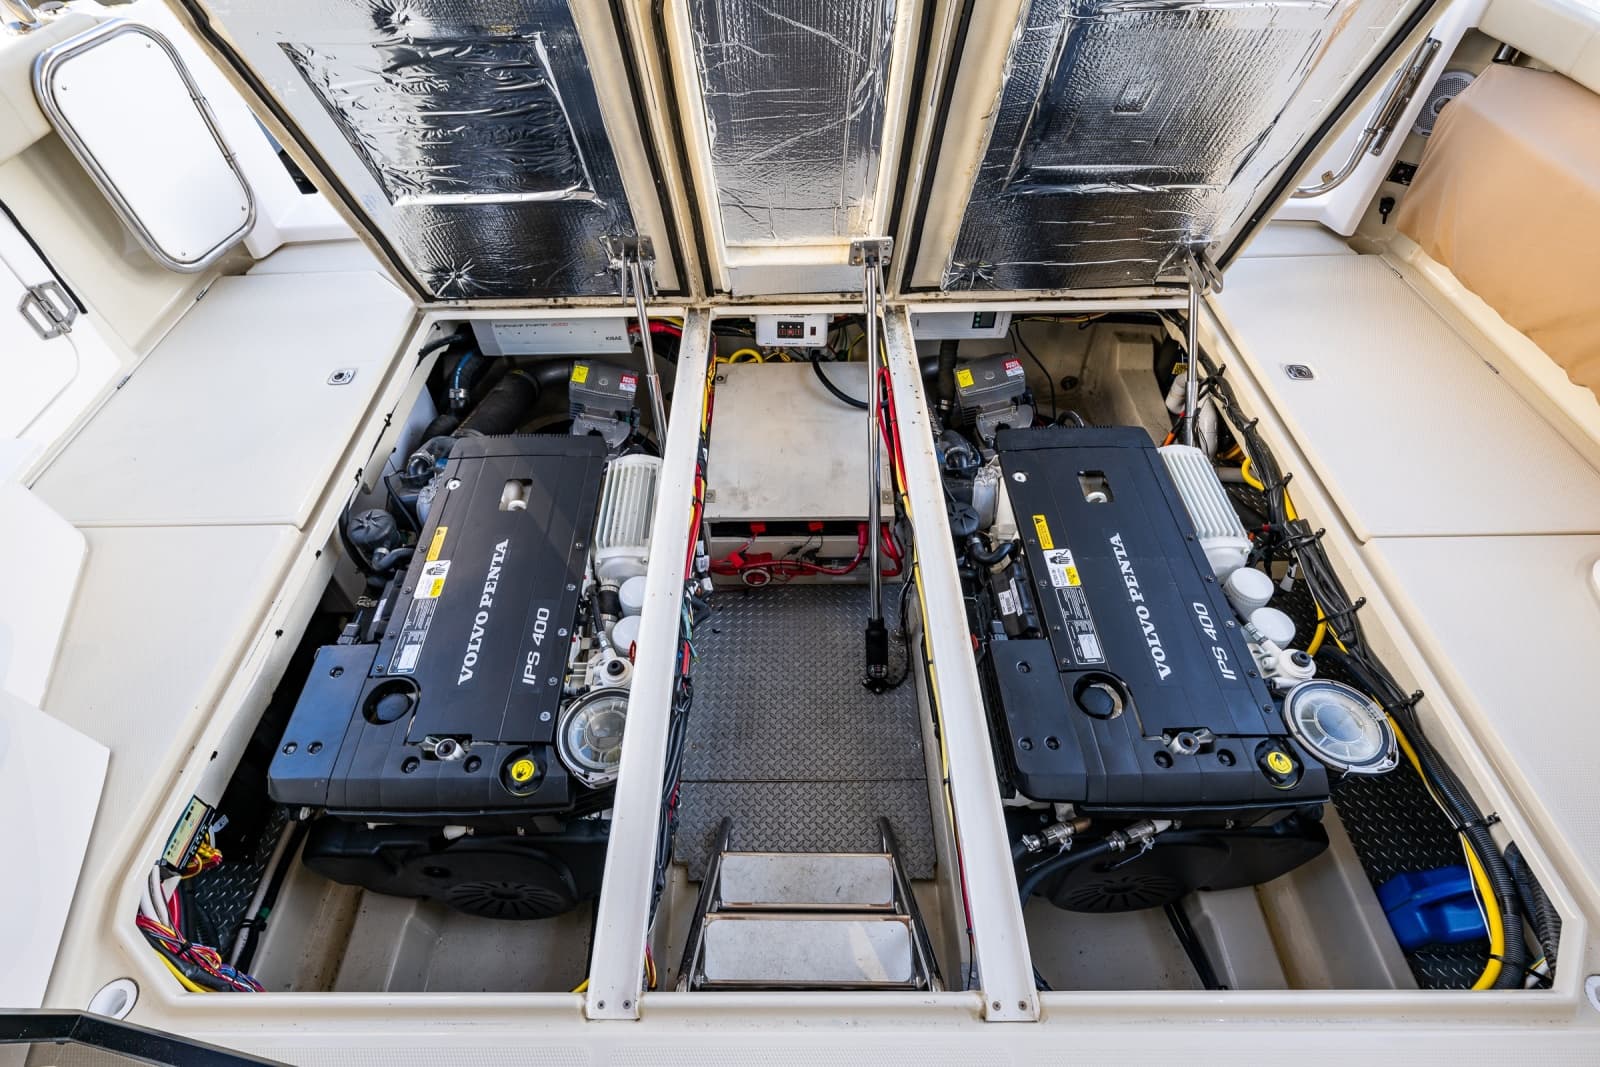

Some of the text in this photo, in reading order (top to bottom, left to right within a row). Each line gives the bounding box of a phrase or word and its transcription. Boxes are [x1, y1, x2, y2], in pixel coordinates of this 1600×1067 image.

[457, 538, 510, 685] VOLVO PENTA
[522, 607, 550, 685] IPS 400
[1109, 532, 1172, 681] VOLVO PENTA
[1192, 602, 1238, 681] IPS 400
